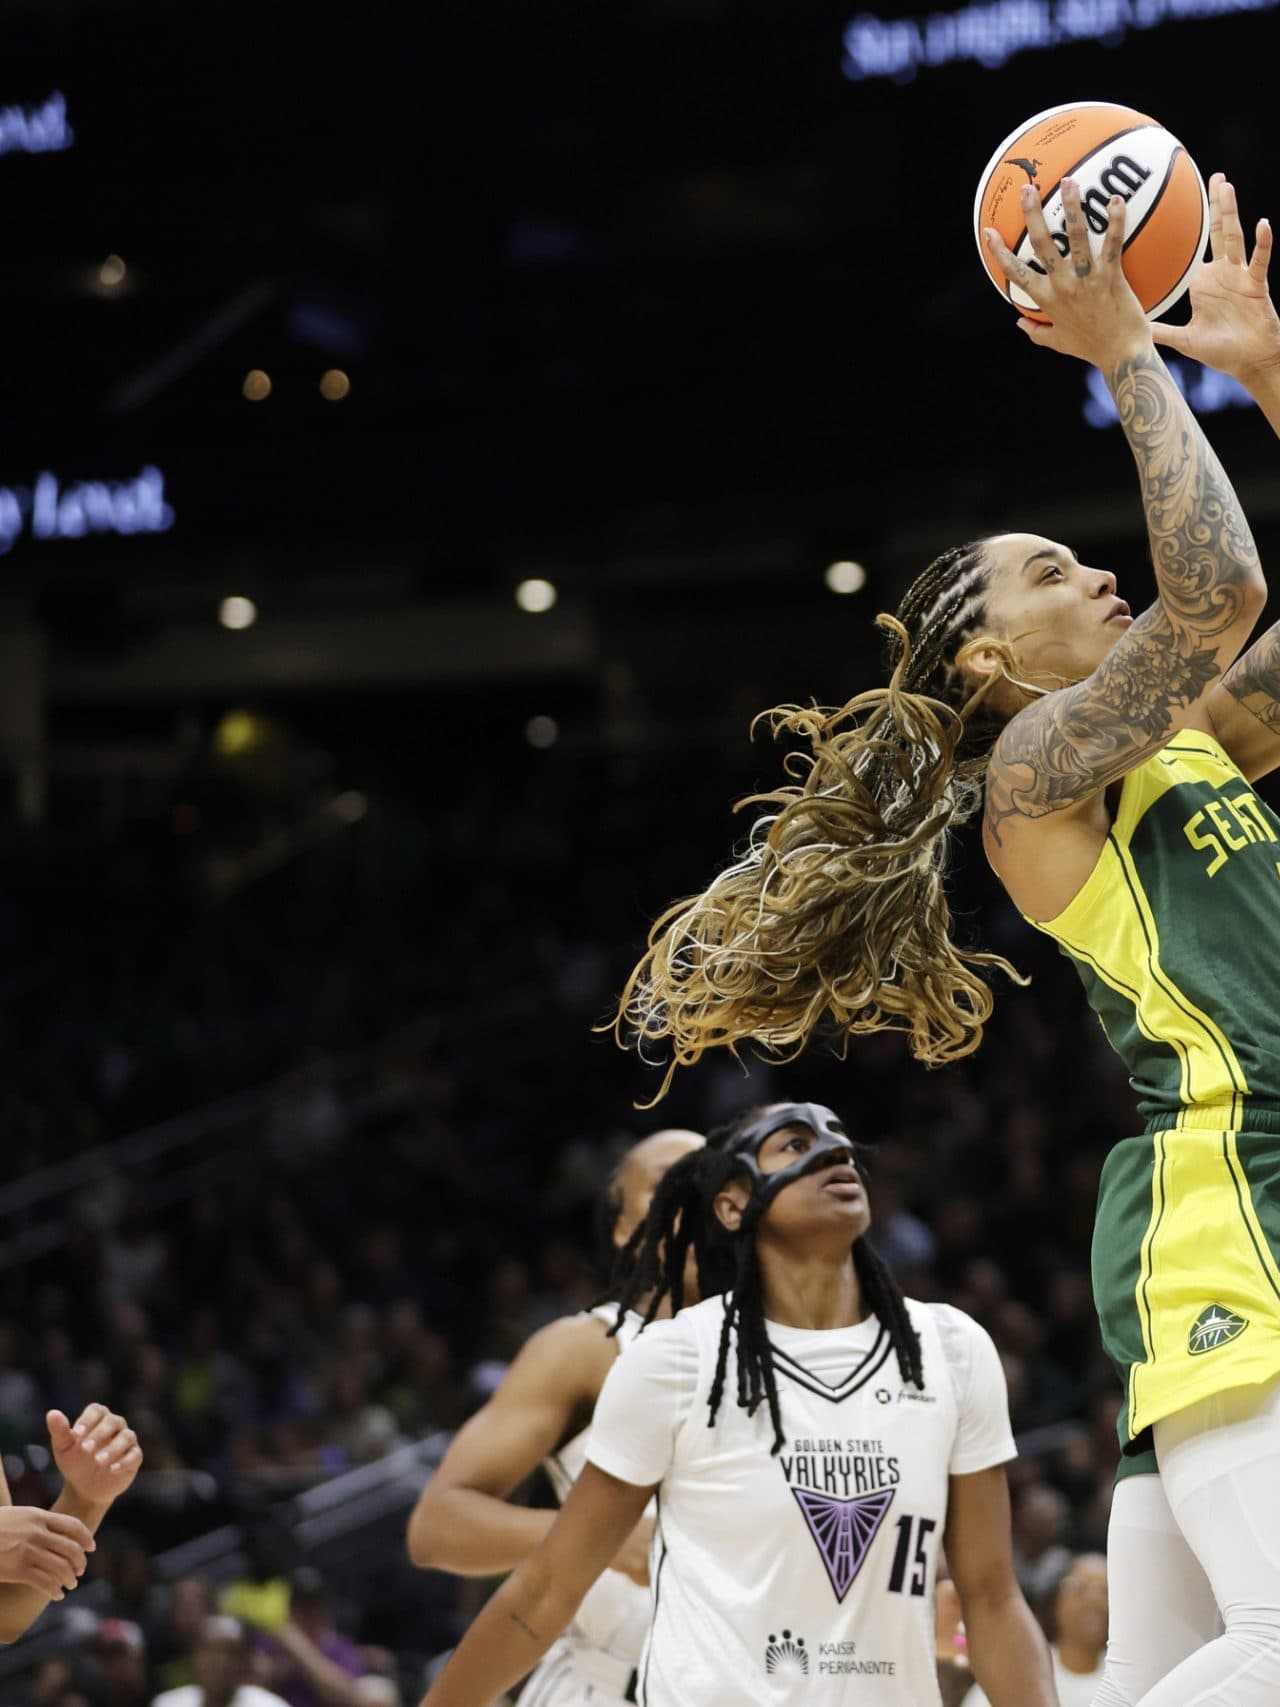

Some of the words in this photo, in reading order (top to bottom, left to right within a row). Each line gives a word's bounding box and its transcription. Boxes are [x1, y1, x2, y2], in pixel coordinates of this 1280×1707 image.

[1028, 154, 1152, 275] Wilo
[780, 1455, 900, 1496] VALKYRIES
[794, 1439, 843, 1453] GOLDEN
[849, 1439, 884, 1453] STATE
[888, 1513, 936, 1597] 15
